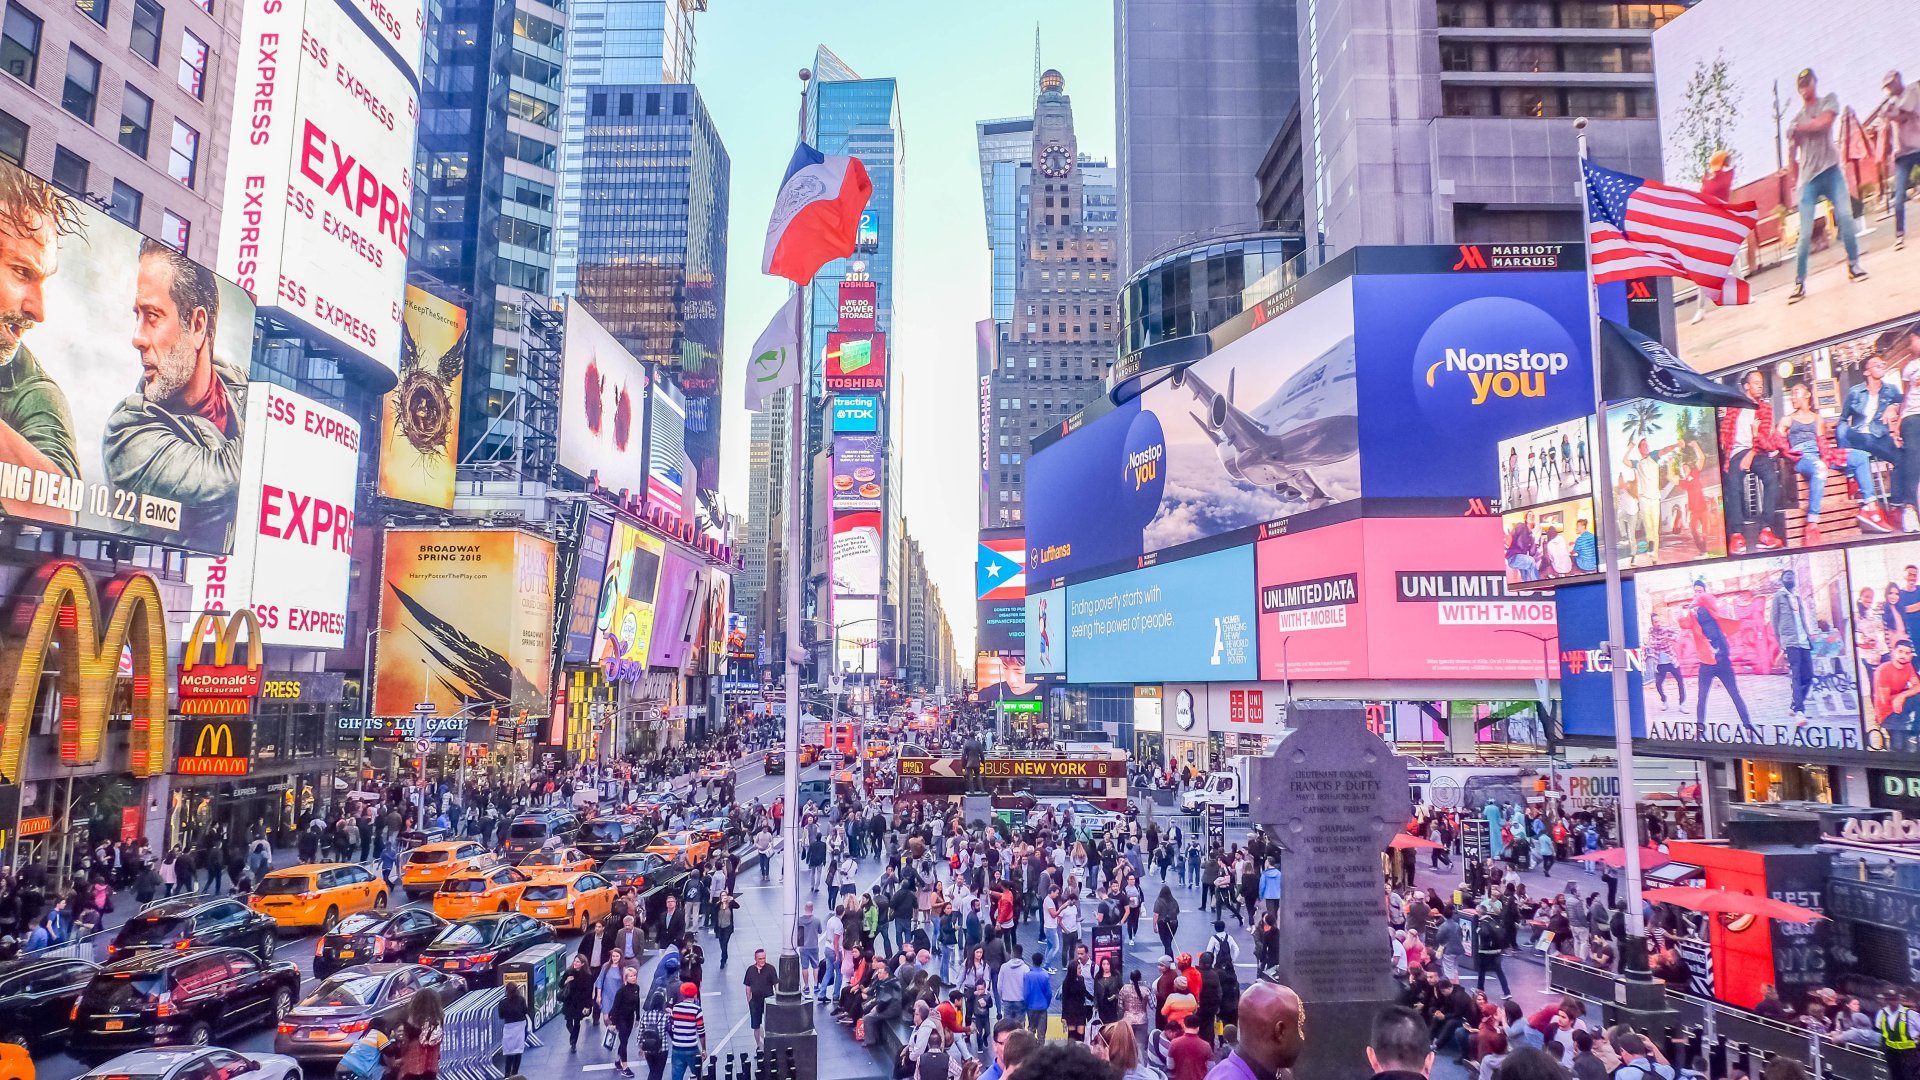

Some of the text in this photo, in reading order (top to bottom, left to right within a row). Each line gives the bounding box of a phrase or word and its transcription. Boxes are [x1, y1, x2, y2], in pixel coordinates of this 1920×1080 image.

[249, 33, 279, 146] EXPRESS
[336, 62, 396, 132] EXPRESS
[236, 176, 266, 296] EXPRESS
[322, 209, 384, 269] EXPRESS
[1492, 245, 1563, 256] MARRIOTT
[1493, 256, 1556, 267] MARQUIS
[1267, 284, 1298, 308] MARRIOTT
[1267, 296, 1294, 318] MARQUIS
[314, 295, 377, 349] EXPRESS
[1445, 348, 1569, 376] Nonstop
[827, 378, 884, 389] TOSHIBA
[1467, 371, 1547, 405] you
[845, 409, 874, 419] TDK
[304, 411, 360, 454] EXPRESS
[1129, 443, 1163, 470] Nonstop
[1135, 460, 1157, 492] you
[32, 468, 85, 513] DEAD
[89, 483, 138, 523] 10.22
[417, 554, 482, 562] SPRING 2018
[419, 545, 481, 554] BROADWAY
[1040, 543, 1072, 564] Lufthansa
[408, 572, 489, 582] HarryPotterThePlay.com
[1071, 584, 1162, 617] Ending poverty starts with
[1264, 578, 1356, 610] UNLIMITED DATA
[289, 608, 346, 636] EXPRESS
[1281, 607, 1345, 628] WITH T-MOBILE
[1442, 604, 1555, 621] WITH T-MOB
[1071, 623, 1093, 640] seeing
[1094, 618, 1105, 635] the
[1106, 617, 1131, 637] power
[1132, 613, 1140, 630] of
[181, 674, 257, 687] McDonald's
[263, 681, 301, 698] PRESS
[1249, 694, 1261, 706] UNI
[338, 718, 382, 730] GIFTS
[1249, 707, 1261, 721] QLO
[1648, 721, 1765, 746] AMERICAN
[1774, 724, 1861, 750] EAGLE
[1014, 762, 1087, 775] NEW YORK
[233, 787, 257, 798] EXPRESS
[1290, 781, 1333, 791] FRANCIS
[1346, 780, 1381, 791] DUFFY
[1569, 776, 1620, 797] PROUD
